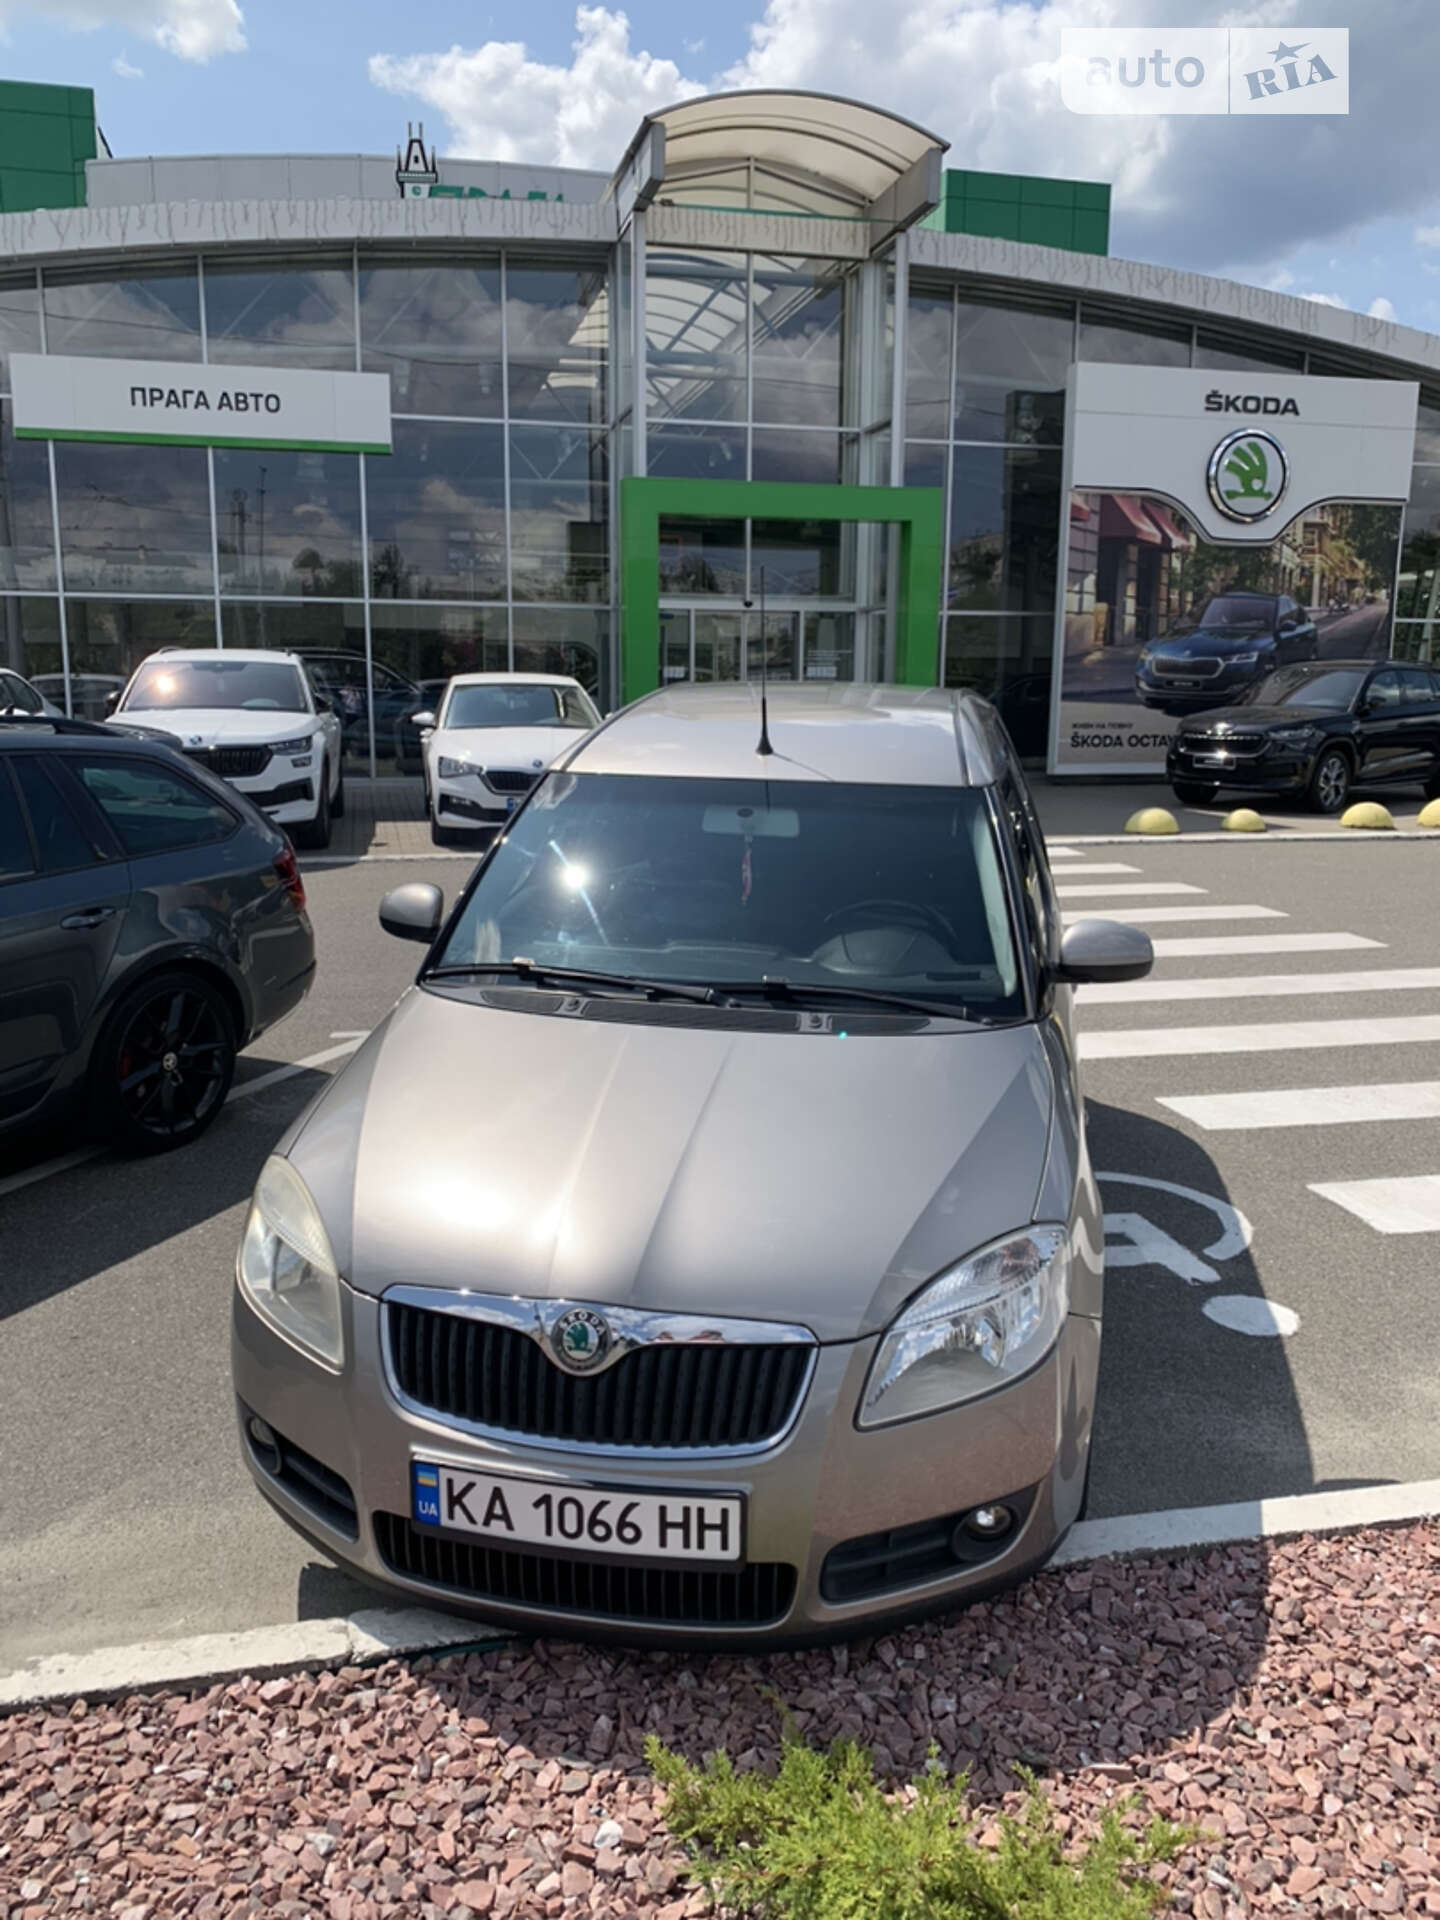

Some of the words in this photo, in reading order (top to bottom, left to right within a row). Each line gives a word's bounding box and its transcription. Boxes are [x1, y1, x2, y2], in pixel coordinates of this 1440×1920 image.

[130, 386, 211, 411] ПРАГА
[217, 391, 282, 414] АВТО
[1204, 389, 1301, 417] ŠKODA
[1070, 731, 1124, 749] ŠKODA
[418, 1501, 438, 1517] UA
[446, 1478, 515, 1532] KA
[532, 1493, 643, 1545] 1066
[658, 1504, 730, 1552] HH
